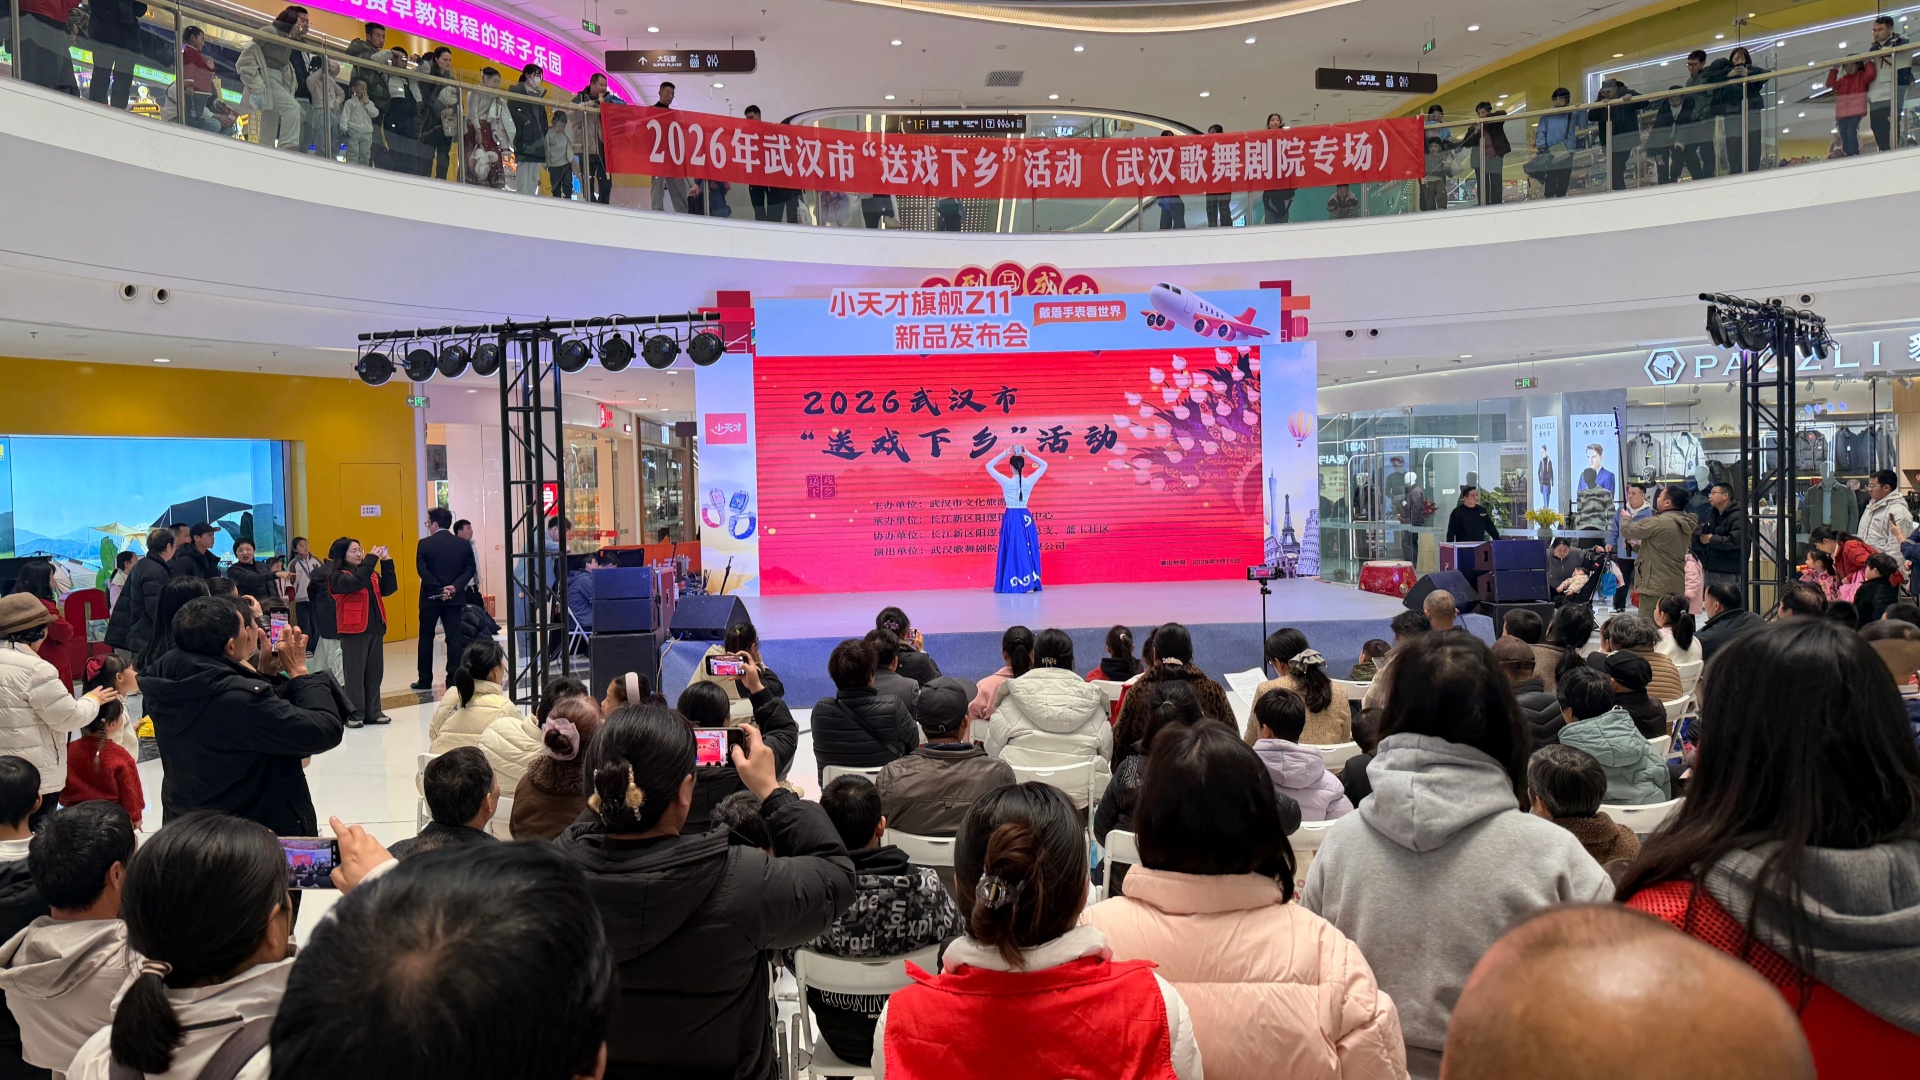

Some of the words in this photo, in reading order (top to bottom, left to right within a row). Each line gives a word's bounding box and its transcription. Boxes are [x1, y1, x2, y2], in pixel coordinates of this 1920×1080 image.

[340, 0, 562, 77] 费早教课程的亲子乐园
[914, 119, 925, 130] 1F
[829, 288, 1010, 317] 小天才旗舰Z11
[1038, 304, 1121, 319] 戴着手表看世界
[895, 321, 1028, 350] 新品发布会
[803, 386, 1018, 416] 2026武汉市
[714, 423, 742, 433] 小天才
[801, 424, 1118, 463] “送戏下乡”活动
[873, 497, 1007, 510] 主办单位：武汉市文化旅游
